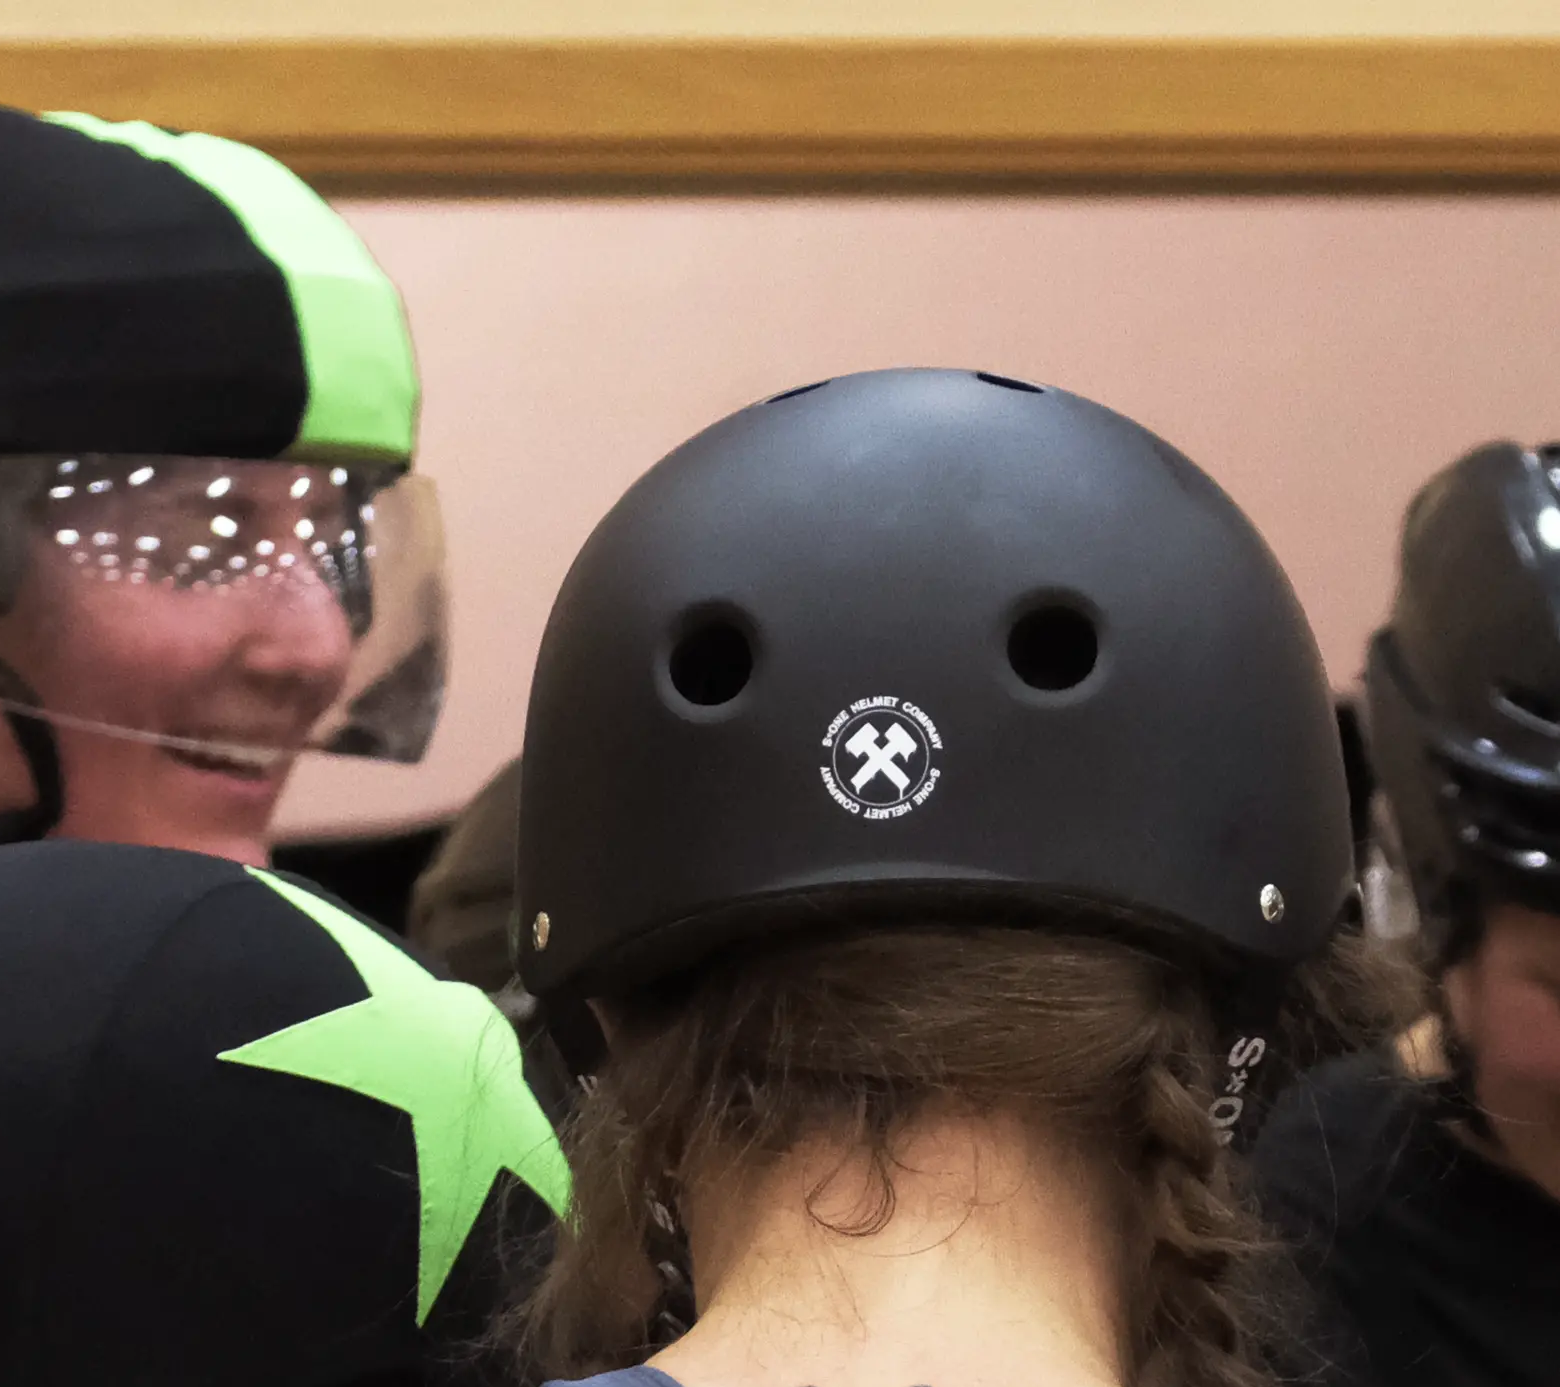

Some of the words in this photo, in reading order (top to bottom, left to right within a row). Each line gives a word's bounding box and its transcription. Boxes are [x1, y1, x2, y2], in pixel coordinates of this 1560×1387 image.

[850, 696, 899, 714] HELMET
[902, 702, 943, 749] COMPANY
[820, 766, 860, 814] COMPANY
[863, 801, 912, 819] HELMET
